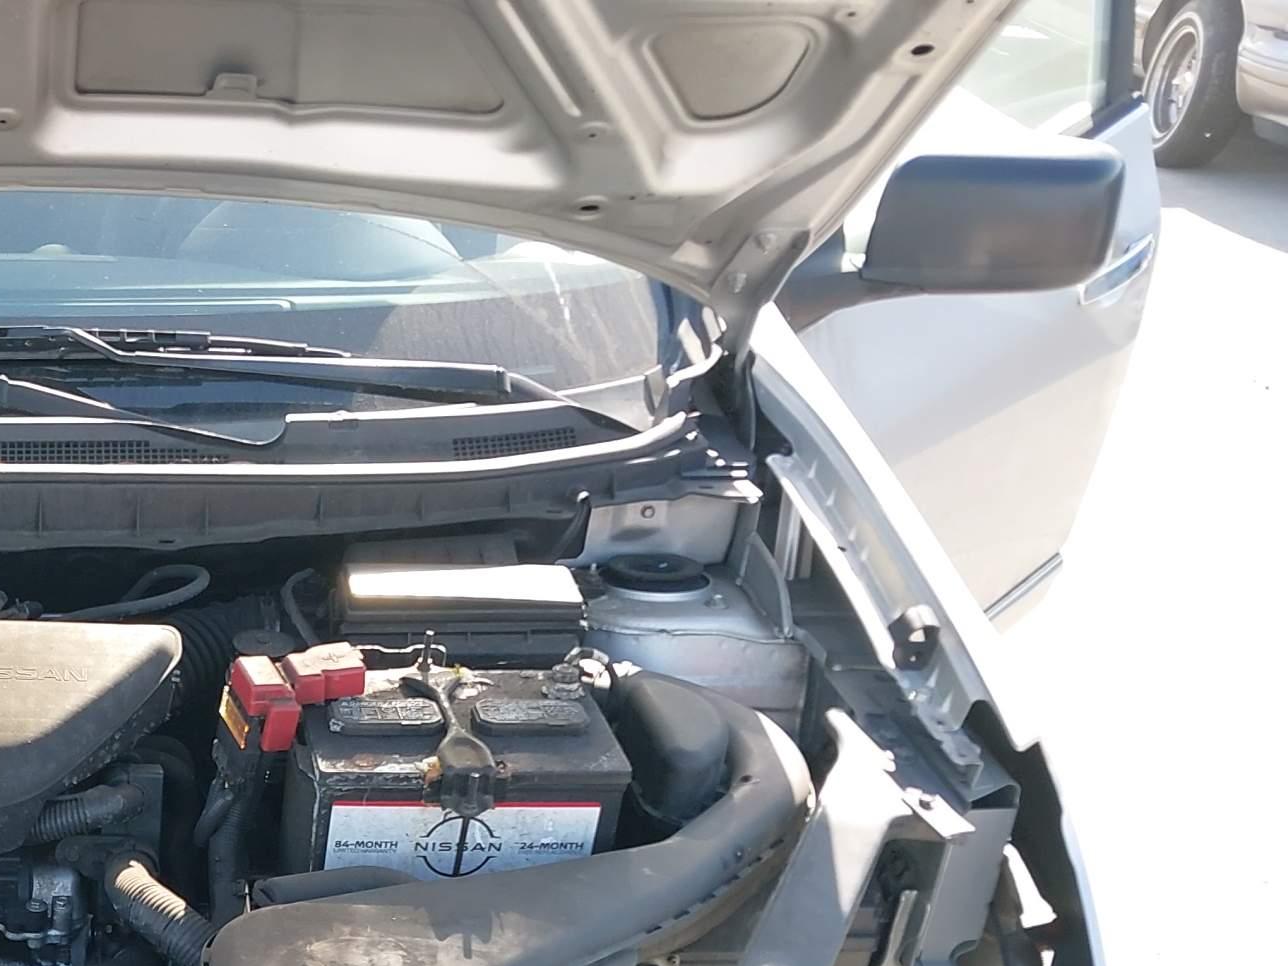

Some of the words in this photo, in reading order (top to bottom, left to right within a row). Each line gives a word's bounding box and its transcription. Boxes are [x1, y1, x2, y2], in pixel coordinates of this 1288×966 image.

[334, 840, 399, 849] 84-MONTH
[414, 842, 503, 852] NISSAN
[519, 842, 585, 850] 24-MONTH
